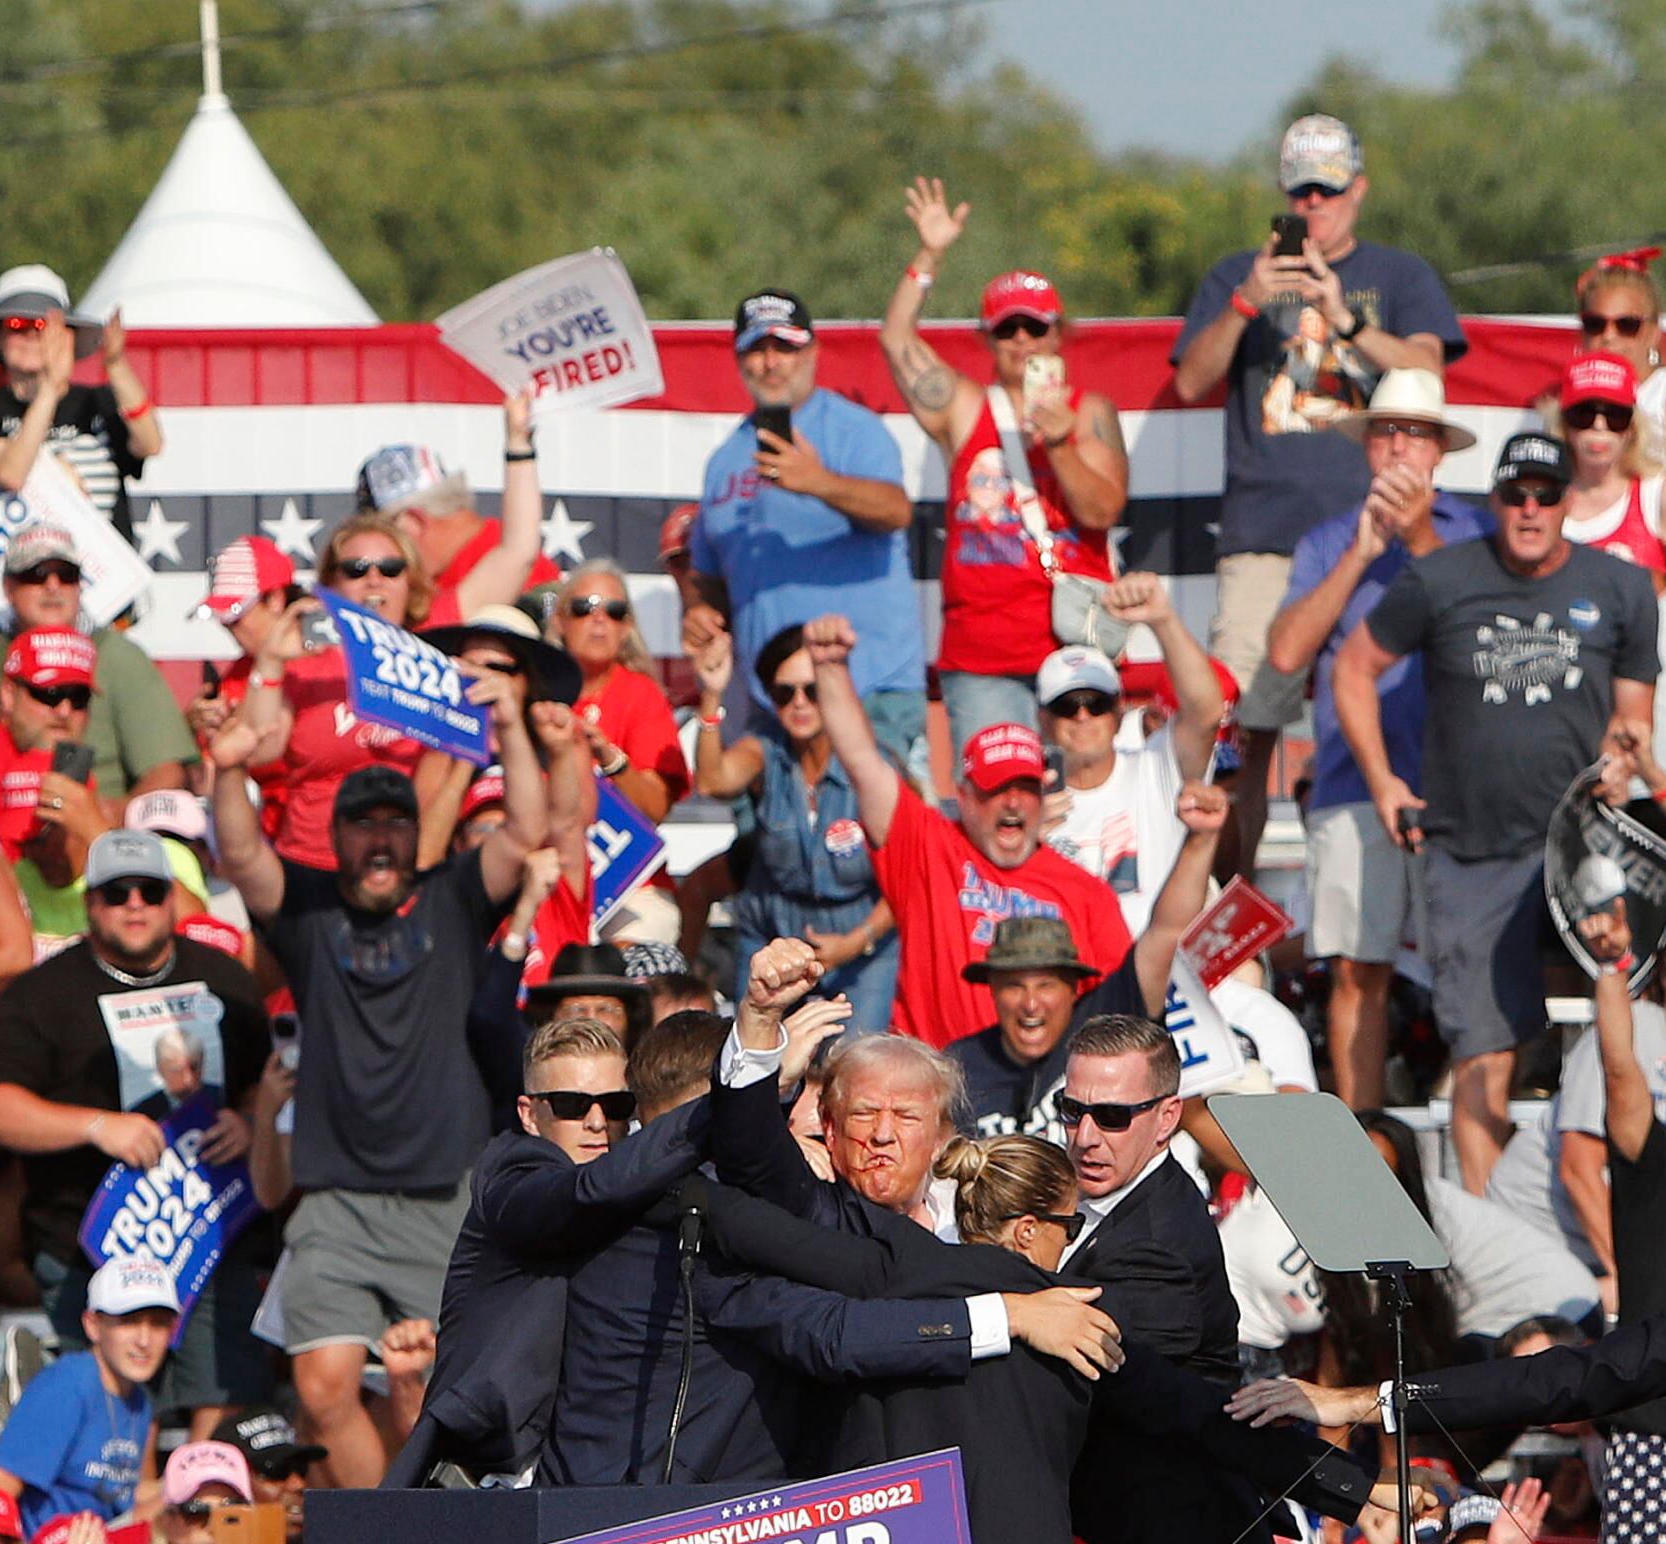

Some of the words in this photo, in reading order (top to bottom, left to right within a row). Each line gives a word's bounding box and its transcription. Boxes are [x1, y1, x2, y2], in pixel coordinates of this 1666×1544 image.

[504, 306, 615, 362] YOU'RE
[531, 341, 634, 397] FIRED!
[371, 645, 462, 707] 2024
[101, 1128, 206, 1263] TRUMP
[814, 1501, 846, 1525] TO
[848, 1483, 914, 1518] 88022
